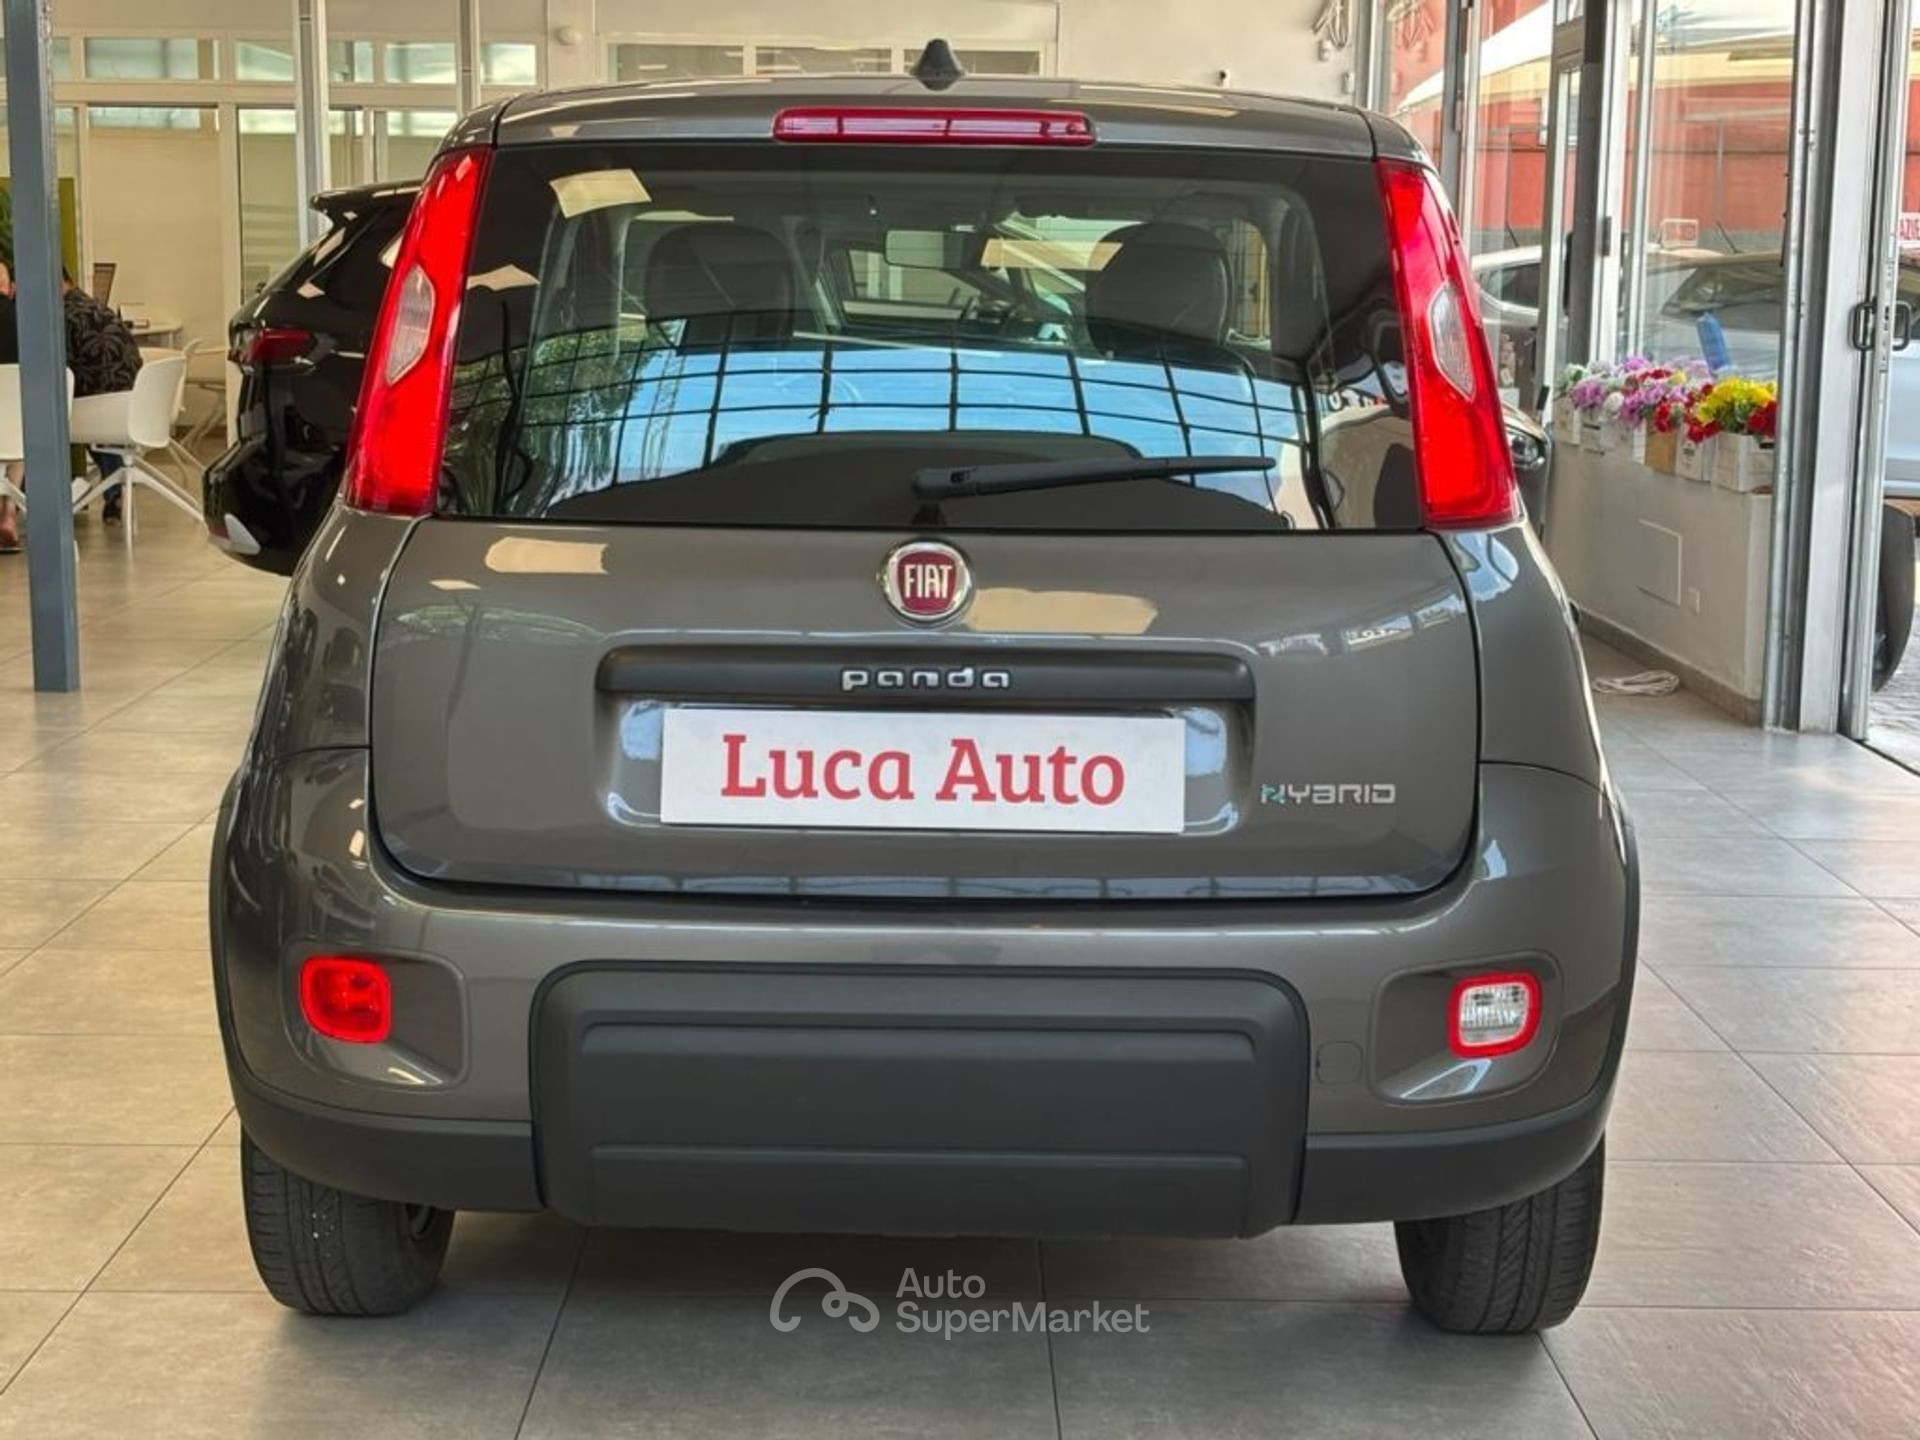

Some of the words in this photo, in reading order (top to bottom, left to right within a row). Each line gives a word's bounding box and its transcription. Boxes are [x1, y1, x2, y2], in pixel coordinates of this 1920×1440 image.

[904, 564, 953, 599] FIAT
[842, 667, 1010, 691] panda
[721, 734, 915, 800] Luca
[935, 738, 1125, 806] Auto
[1260, 783, 1397, 805] HYBRID
